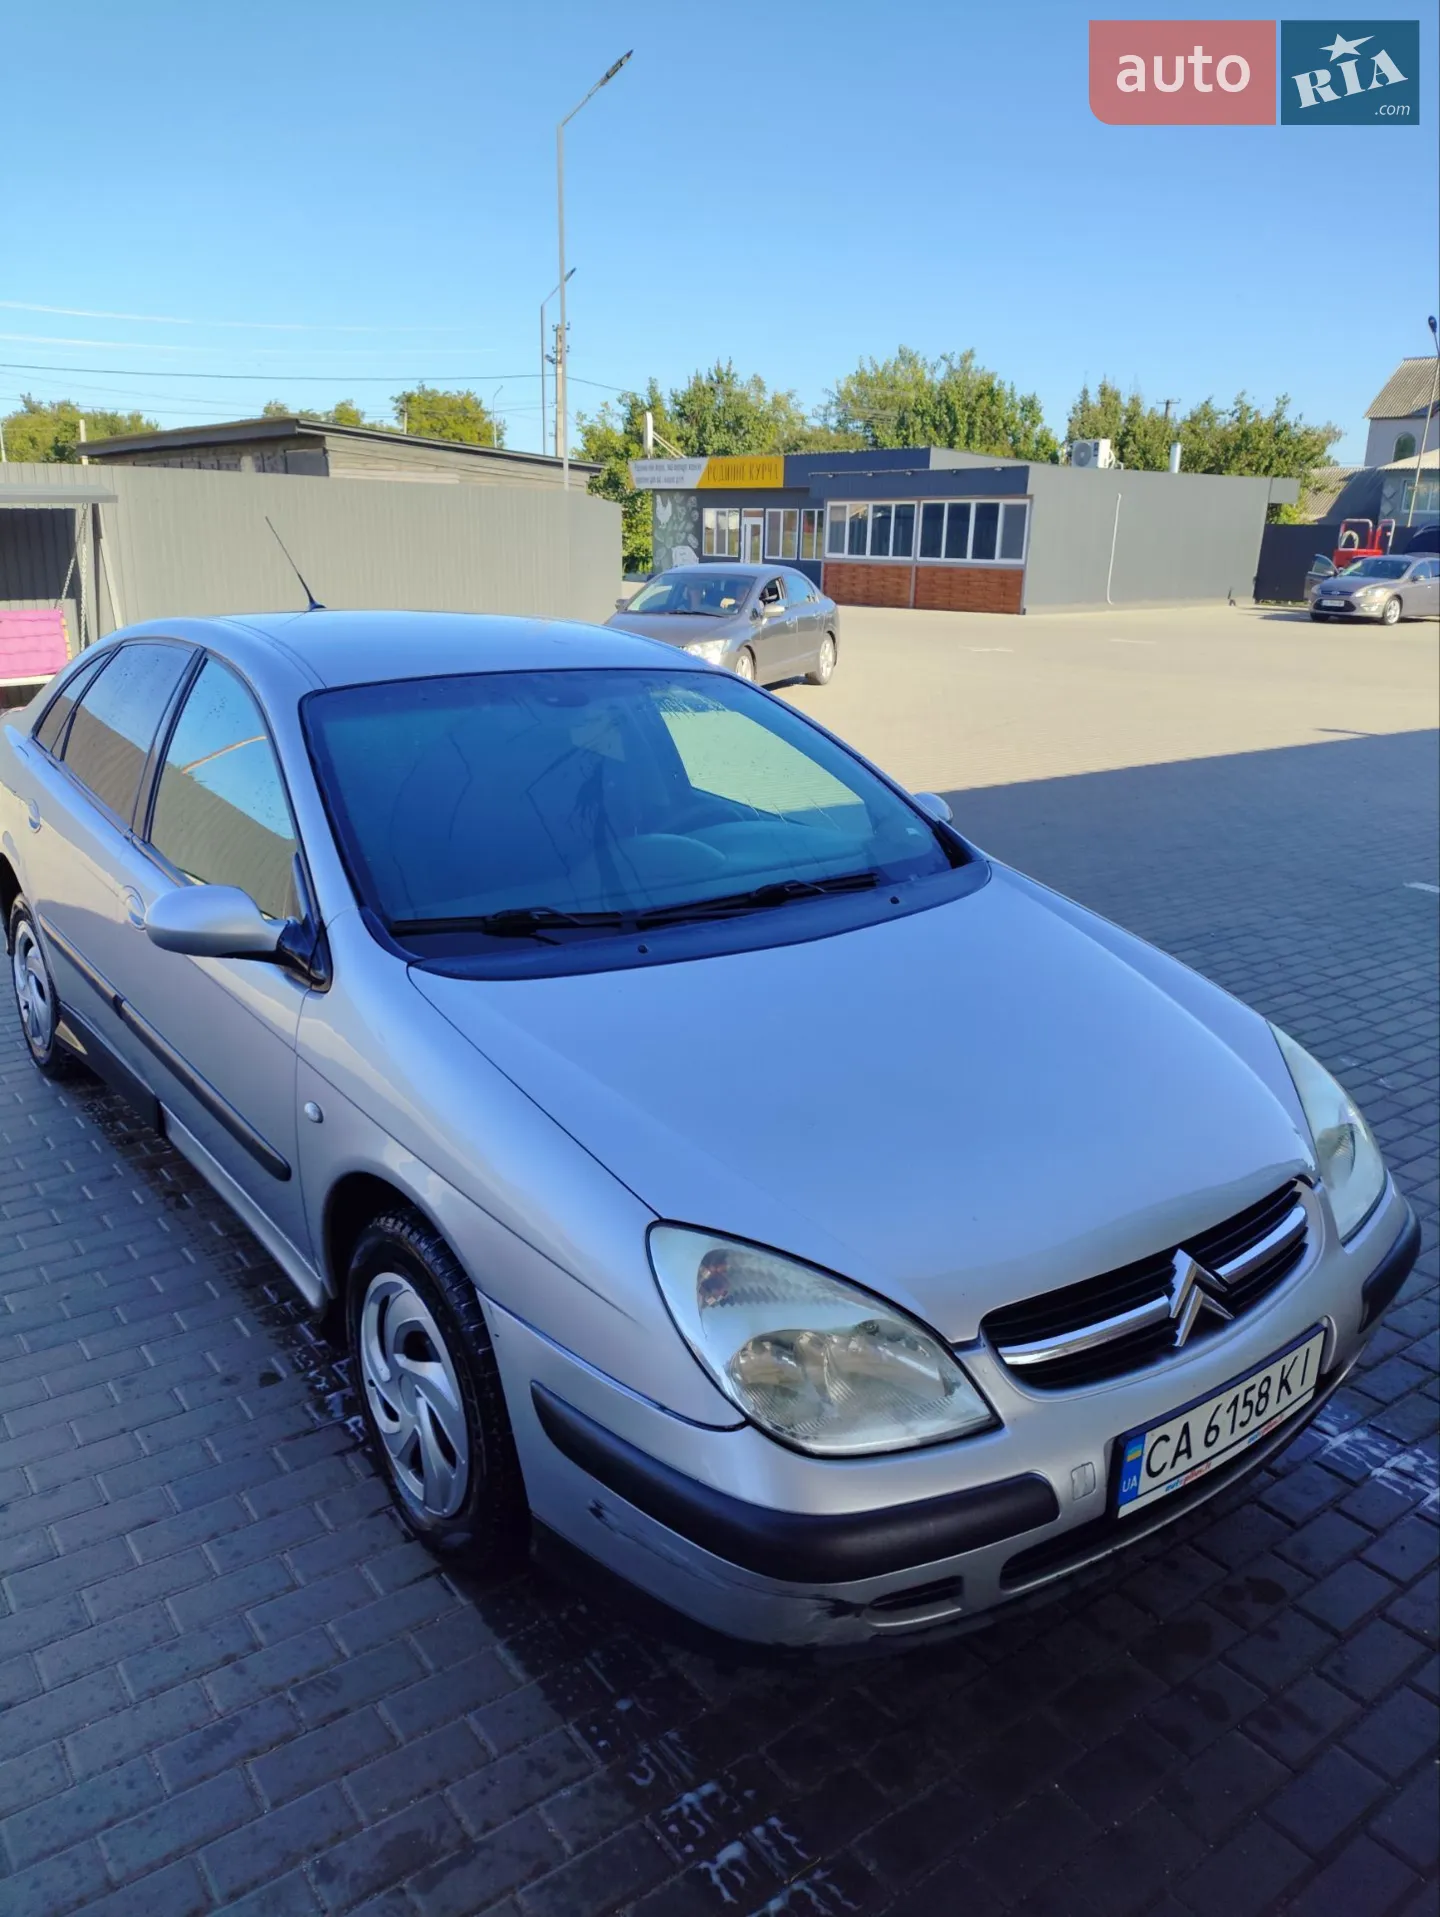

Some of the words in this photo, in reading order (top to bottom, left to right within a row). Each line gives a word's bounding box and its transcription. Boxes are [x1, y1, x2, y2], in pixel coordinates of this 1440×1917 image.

[1145, 1421, 1192, 1479] CA
[1203, 1375, 1271, 1449] 6158
[1276, 1347, 1310, 1405] KI
[1121, 1478, 1138, 1493] UA
